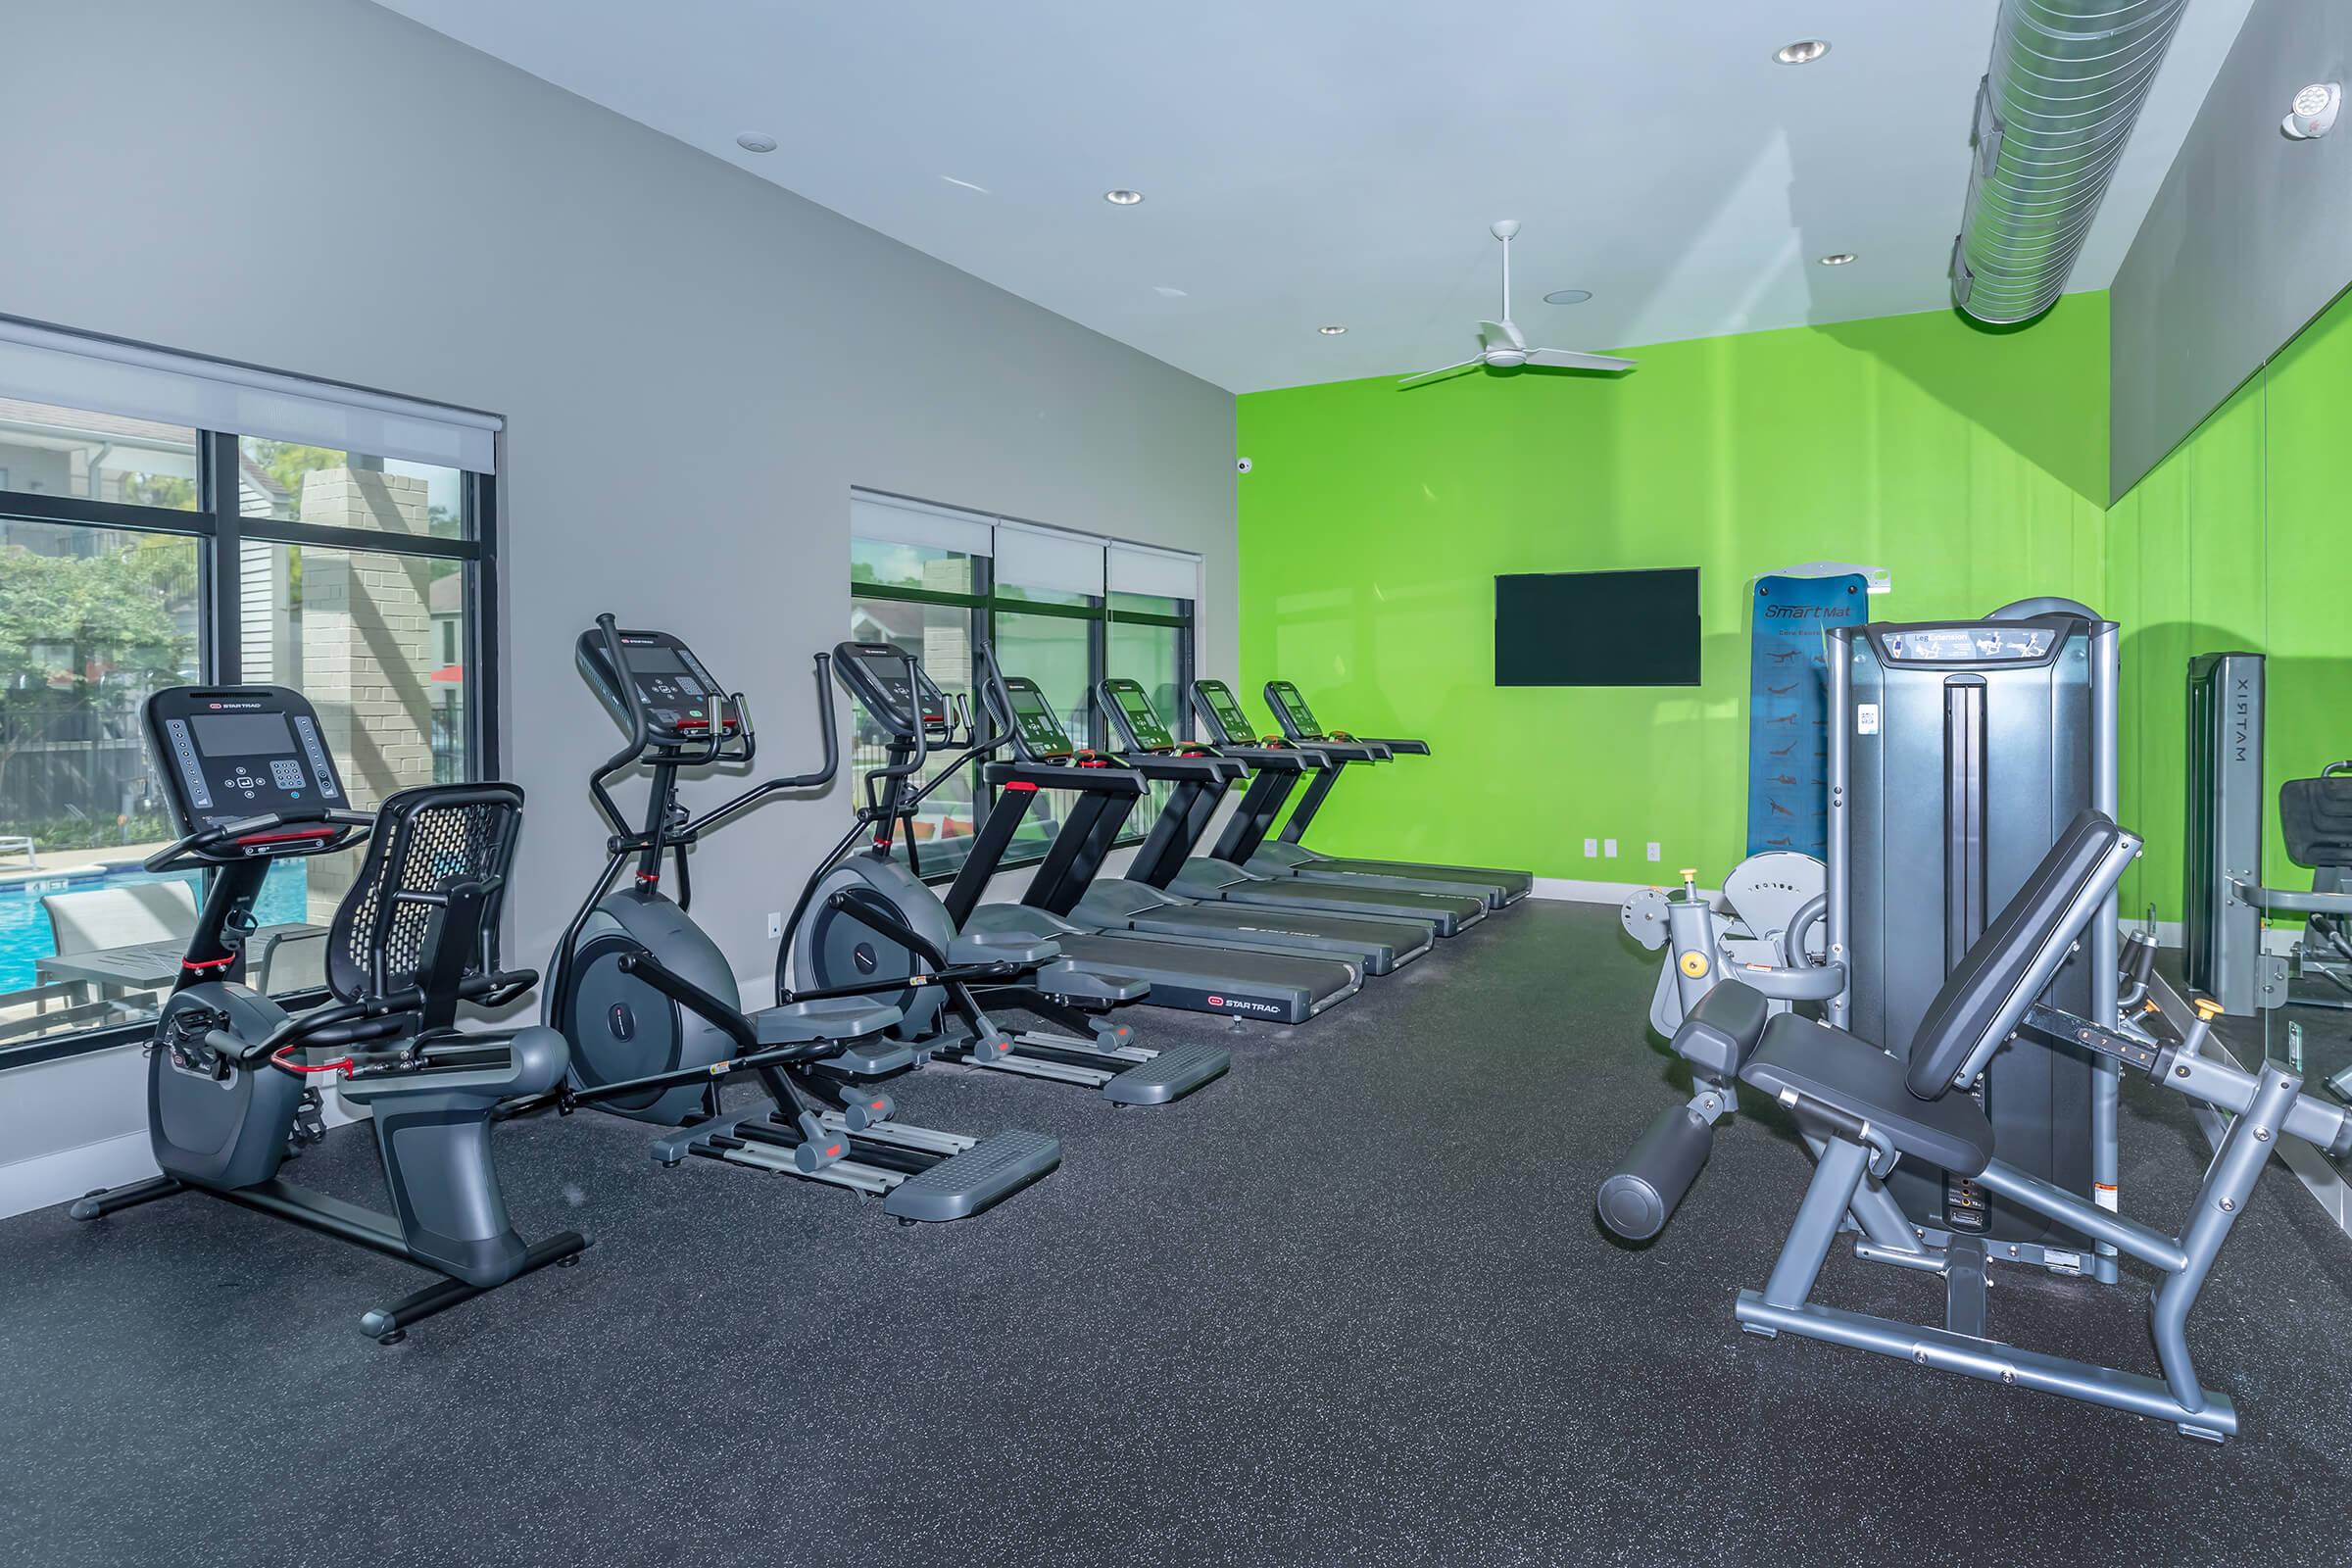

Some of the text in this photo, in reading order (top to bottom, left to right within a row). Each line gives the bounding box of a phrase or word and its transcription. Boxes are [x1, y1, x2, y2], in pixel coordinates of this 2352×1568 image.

[1765, 604, 1850, 618] Smart Mat
[1225, 1000, 1281, 1013] STAR TRAC
